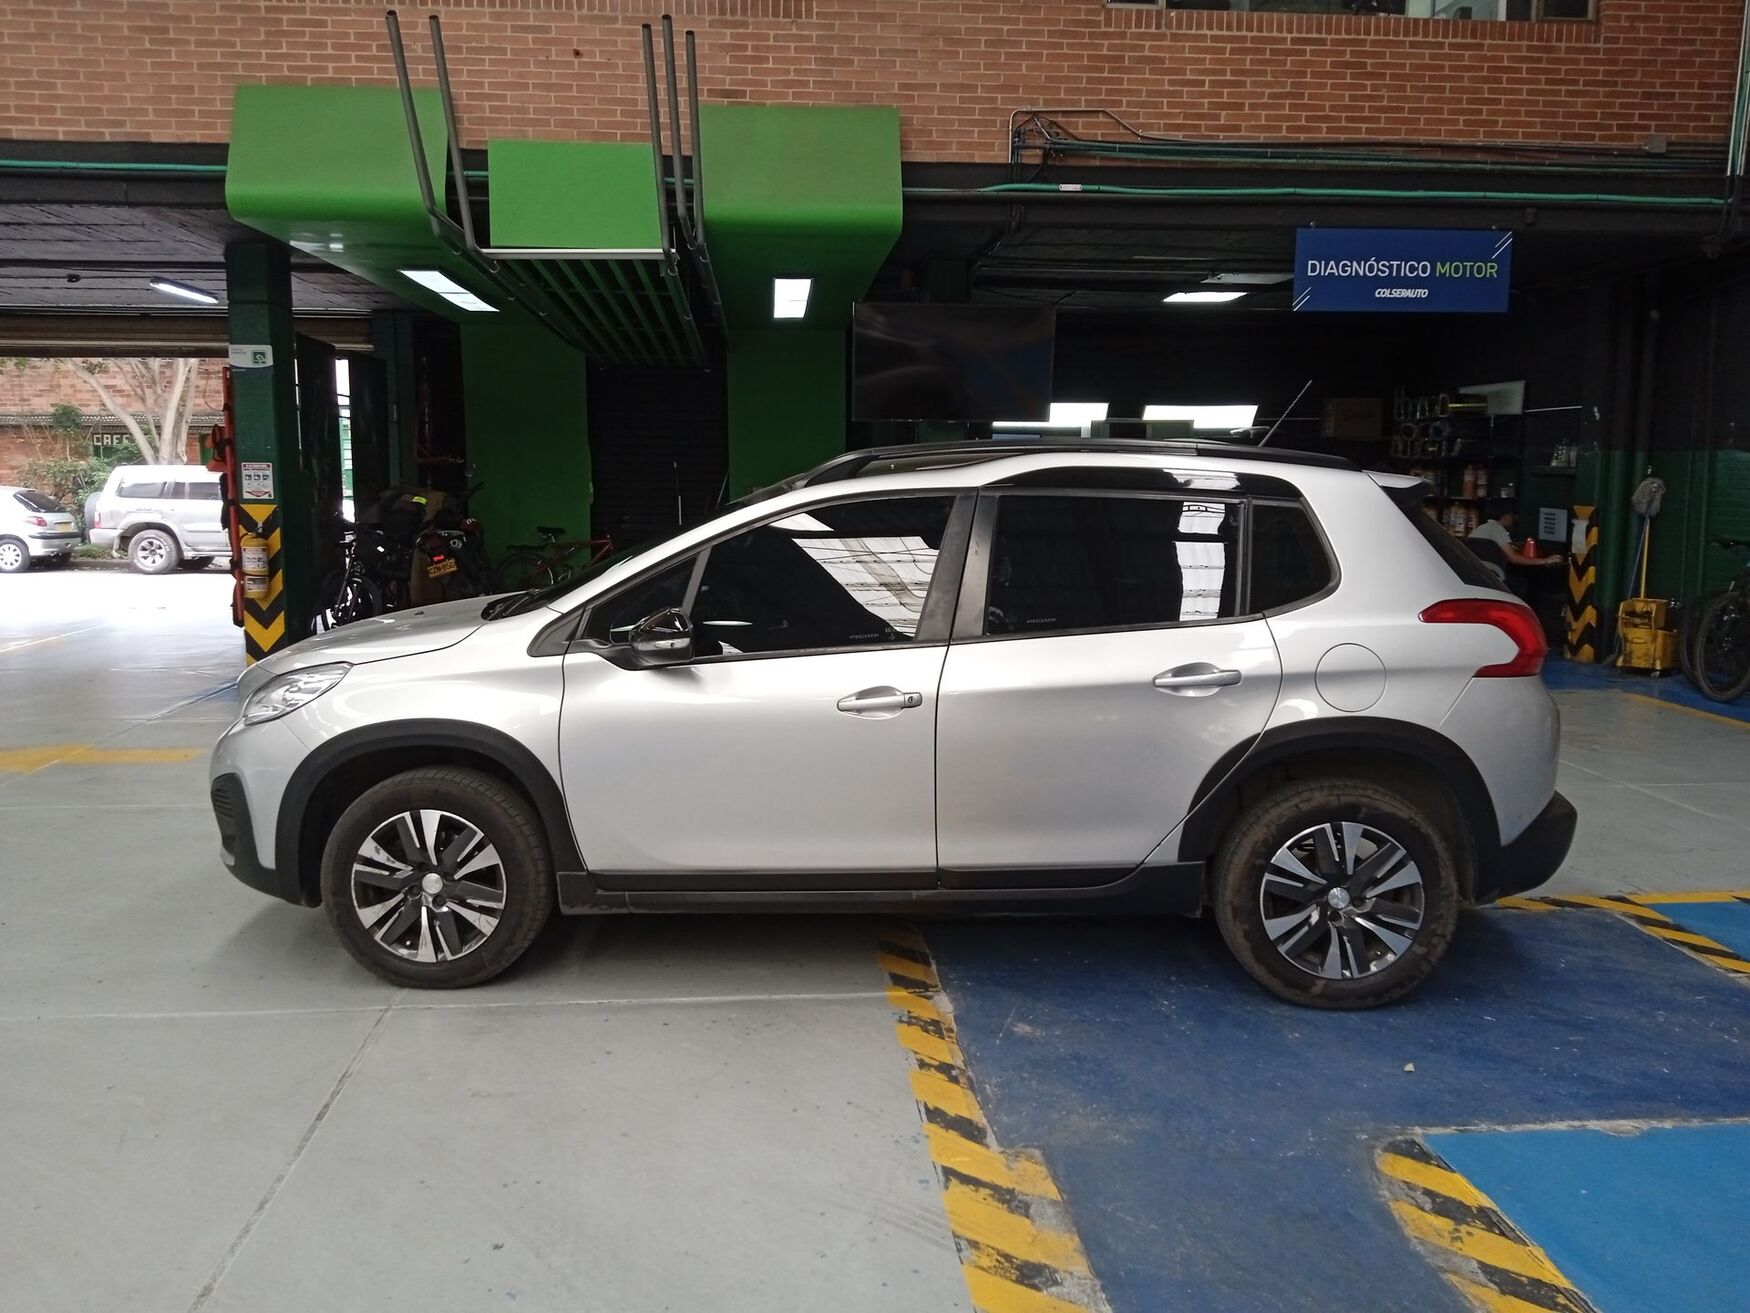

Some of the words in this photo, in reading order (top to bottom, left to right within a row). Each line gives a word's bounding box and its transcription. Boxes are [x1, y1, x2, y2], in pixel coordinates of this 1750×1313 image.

[1307, 257, 1431, 277] DIAGNÓSTICO
[1435, 262, 1498, 278] MOTOR
[1375, 288, 1429, 298] COLSERAUTO
